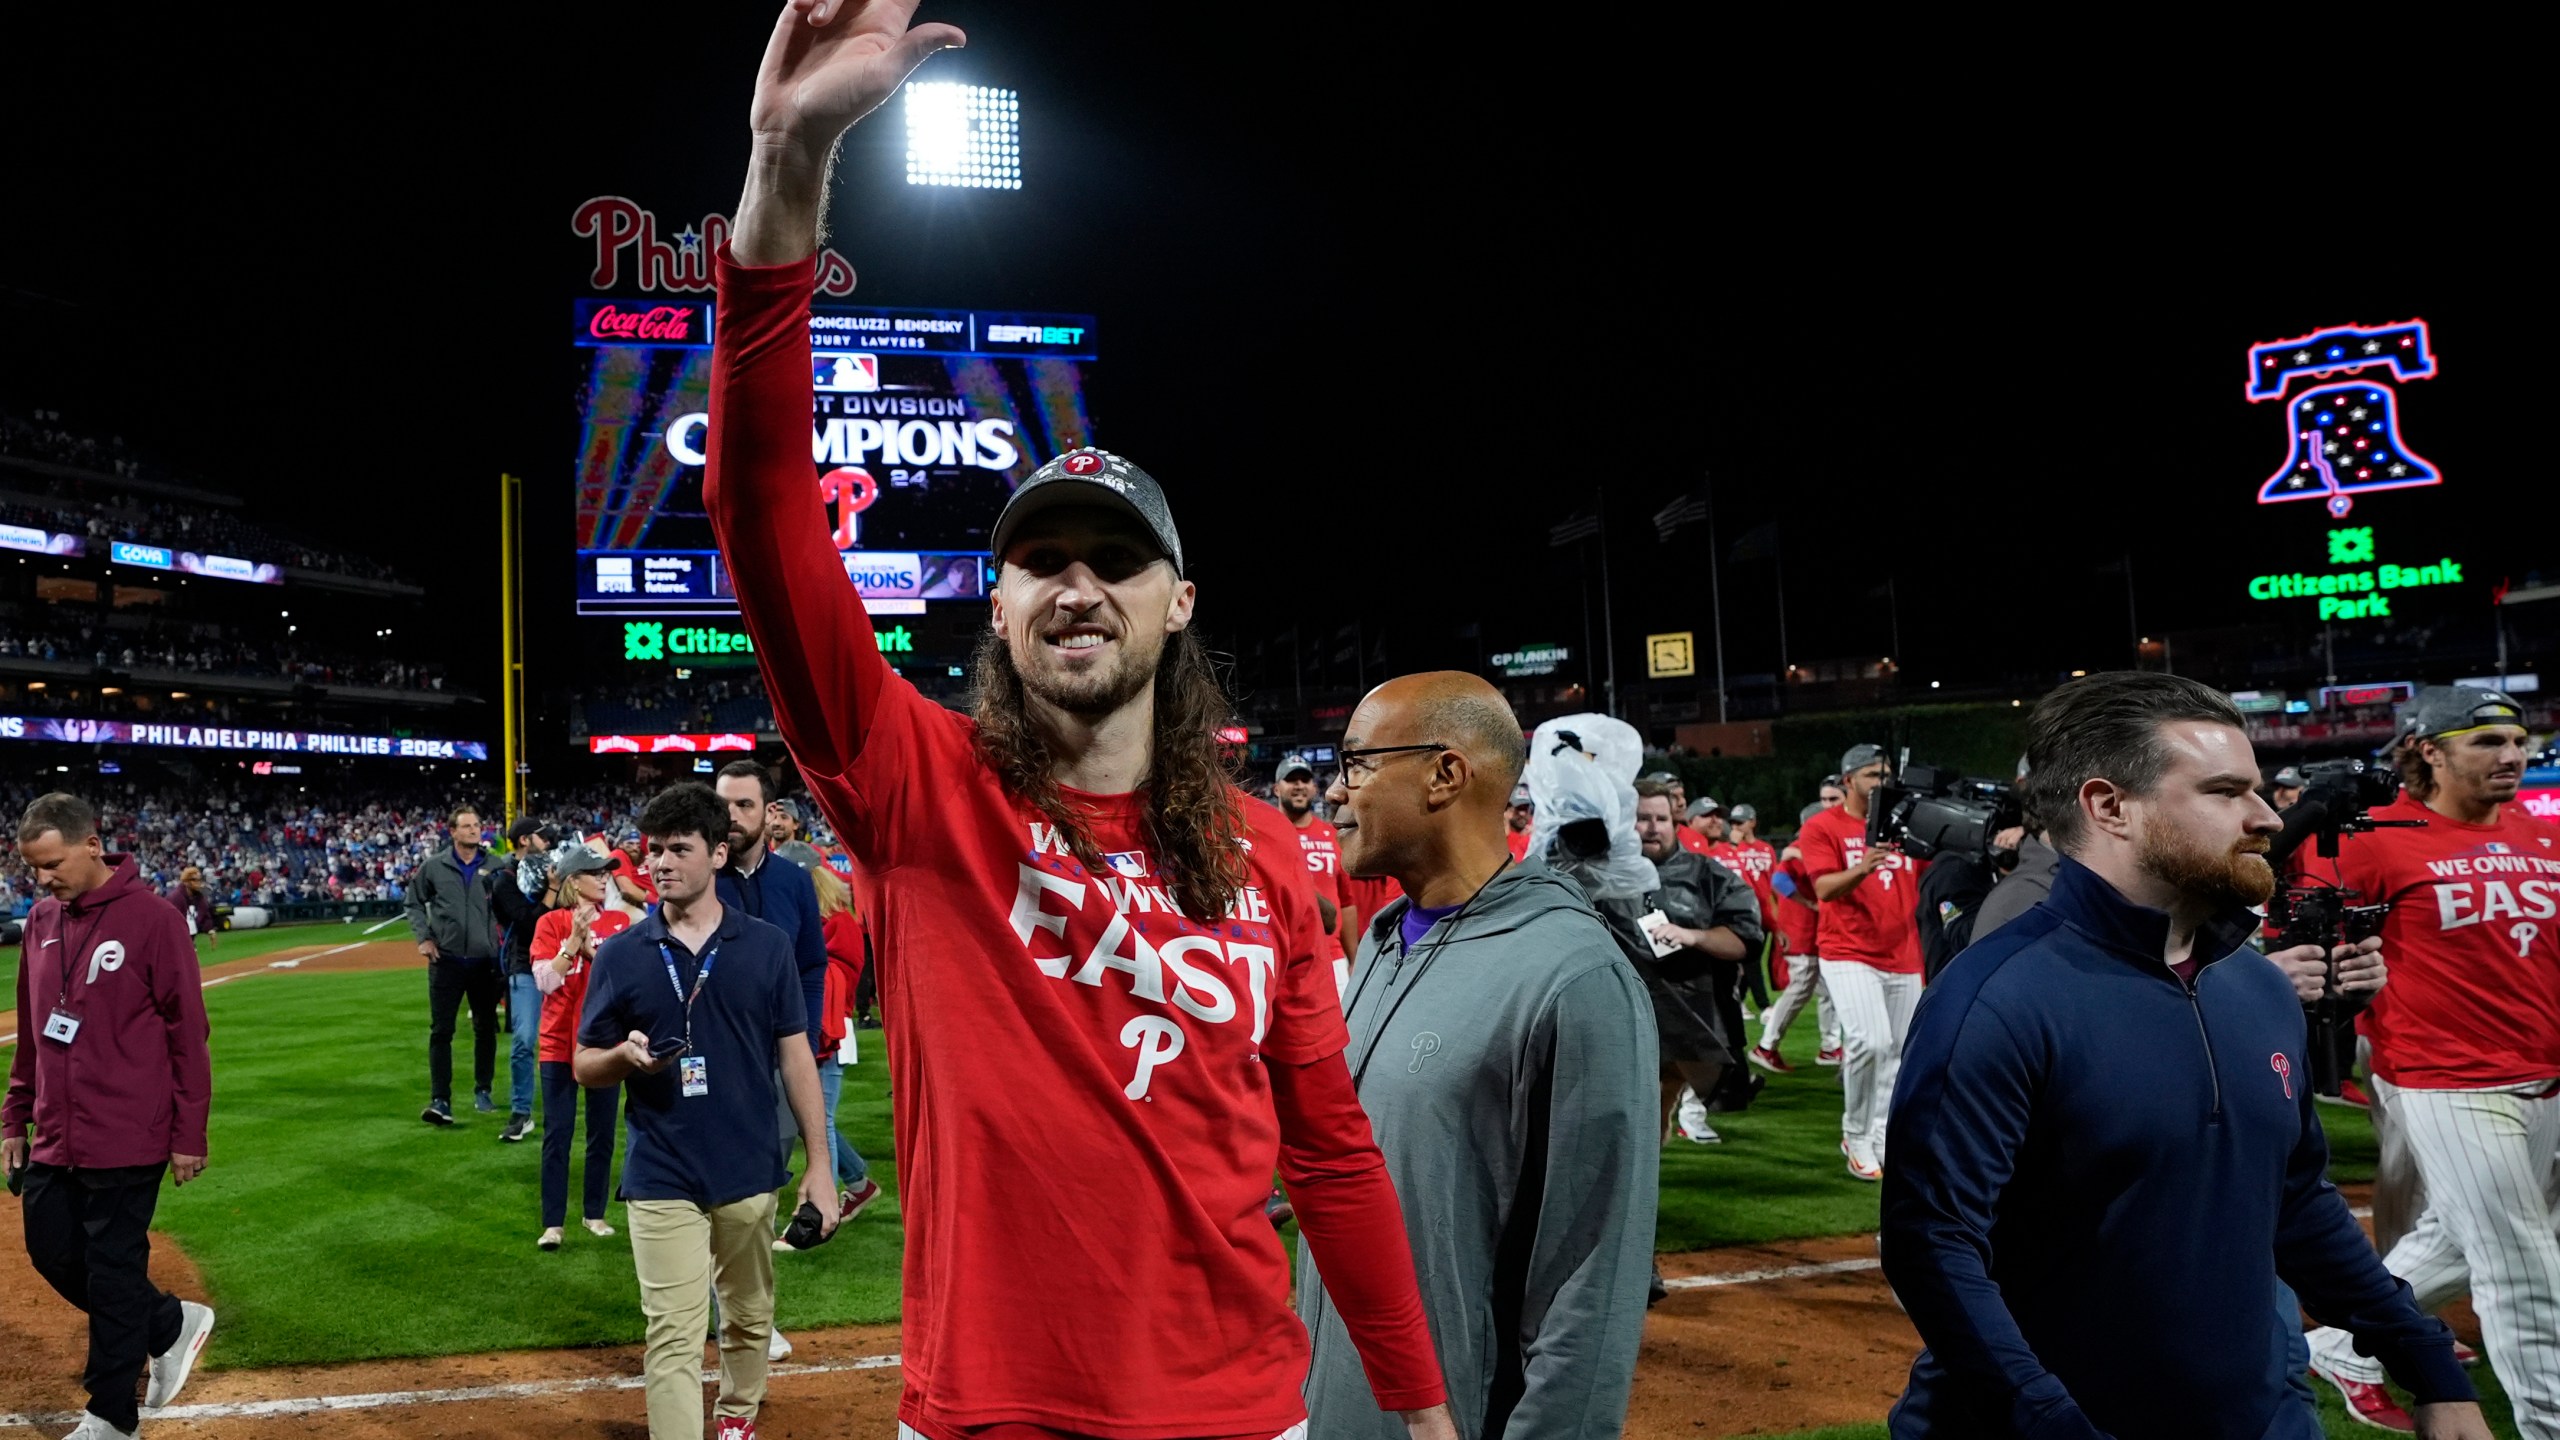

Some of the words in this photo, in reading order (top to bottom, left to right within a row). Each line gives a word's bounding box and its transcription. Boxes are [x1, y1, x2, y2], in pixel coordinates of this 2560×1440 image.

[590, 305, 694, 339] Coca-Cola
[895, 319, 963, 333] BENDESKY
[861, 336, 926, 349] LAWYERS
[843, 396, 965, 417] DIVISION
[666, 412, 1018, 470] CMPIONS
[1072, 456, 1095, 472] P
[120, 545, 163, 564] GOYA
[2249, 571, 2375, 600] Citizens
[2378, 557, 2464, 589] Bank
[2318, 591, 2391, 621] Park
[1491, 652, 1513, 666] CP
[131, 723, 298, 750] PHILADELPHIA
[307, 733, 390, 755] PHILLIES
[400, 740, 456, 758] 2024
[1029, 822, 1071, 857] W
[2426, 857, 2473, 877] WE
[2473, 856, 2530, 874] OWN
[1091, 876, 1187, 917] WN
[1008, 861, 1276, 1047] EAST
[2509, 921, 2539, 958] P
[86, 940, 125, 984] P
[1119, 1014, 1185, 1101] P
[1408, 1031, 1441, 1074] P
[2270, 1052, 2292, 1099] P
